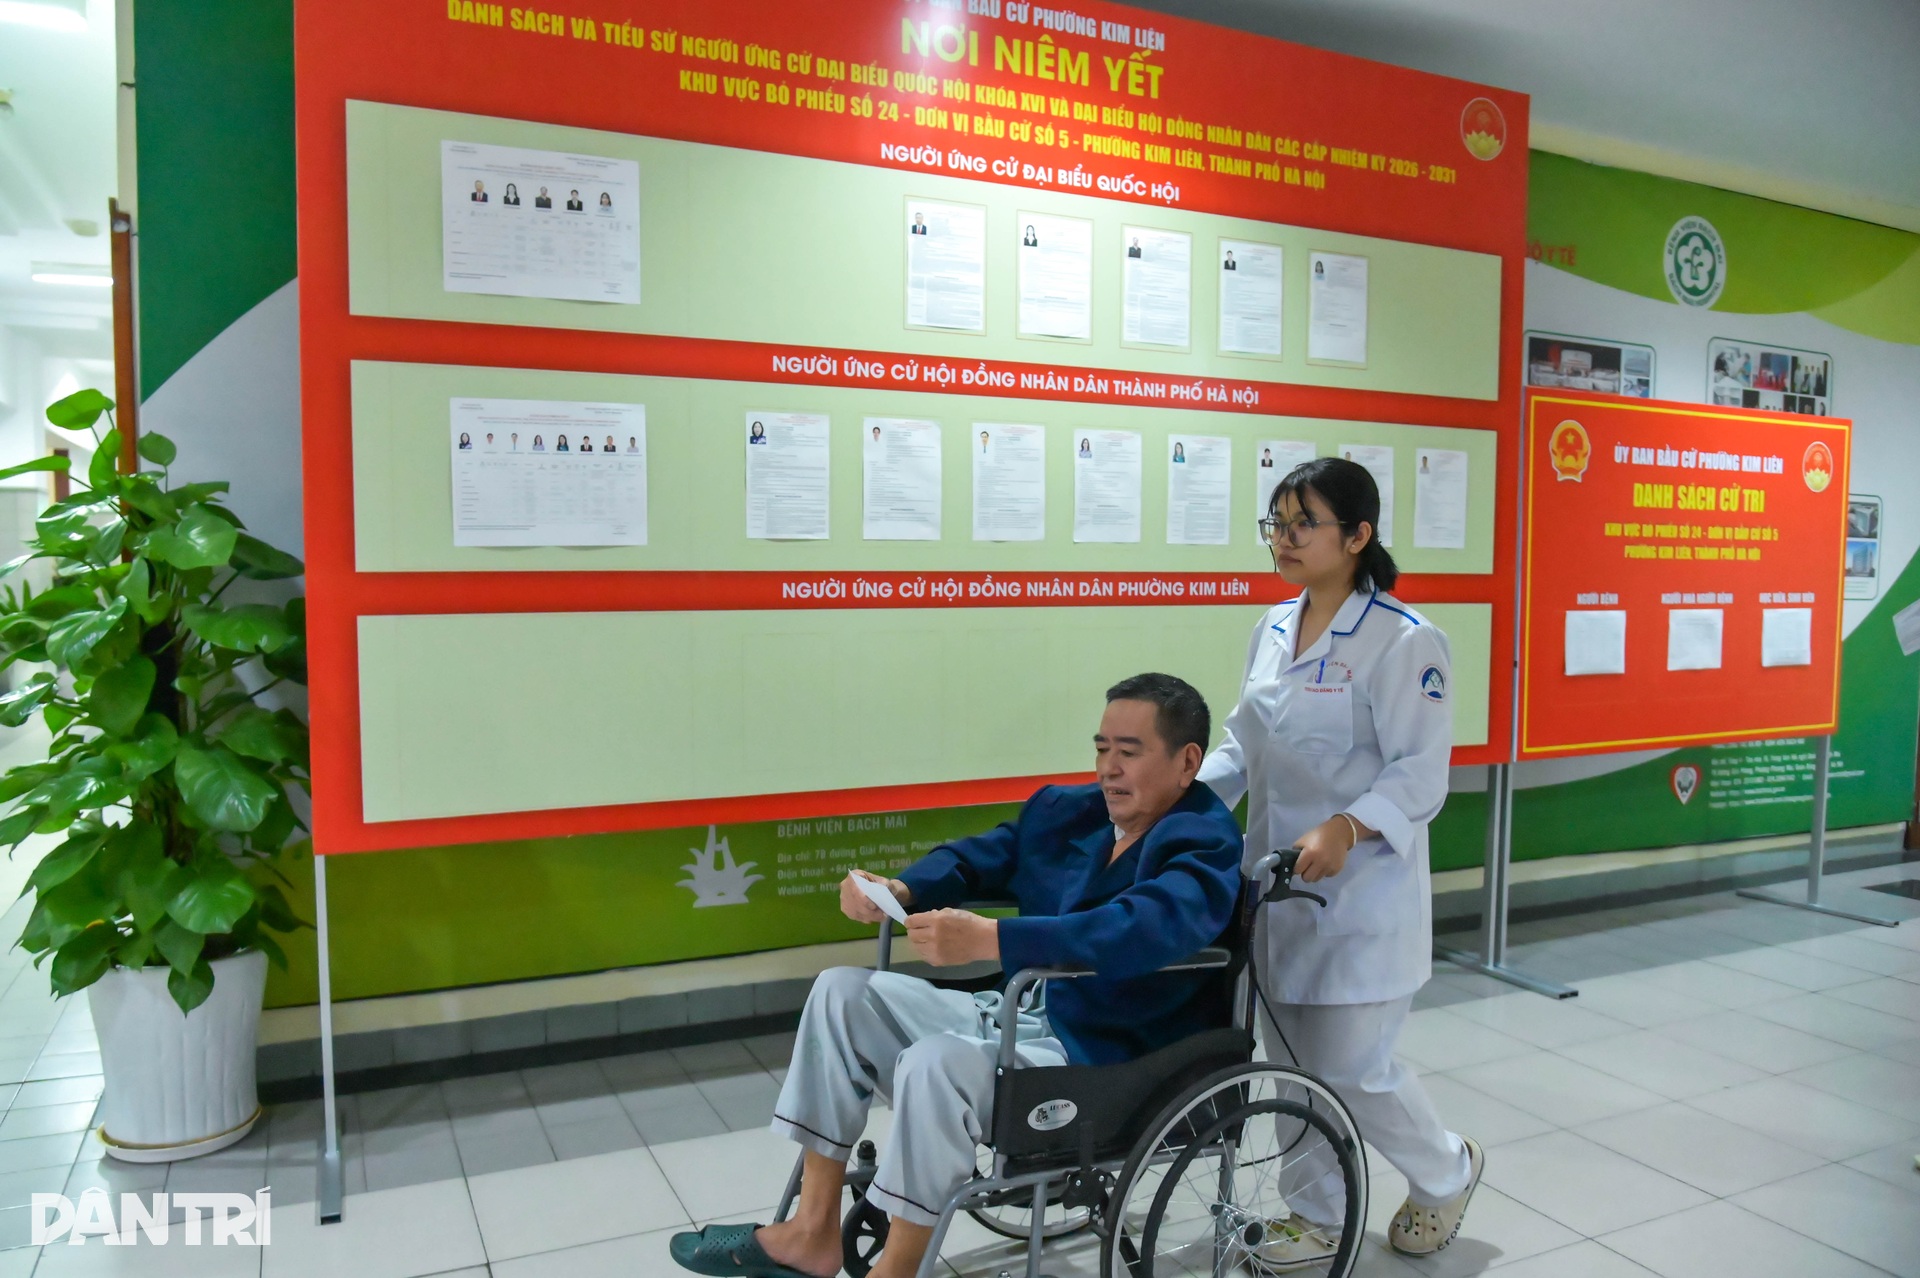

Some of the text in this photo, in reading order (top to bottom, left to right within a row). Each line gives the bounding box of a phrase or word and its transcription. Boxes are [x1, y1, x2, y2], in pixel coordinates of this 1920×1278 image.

[1033, 9, 1096, 38] PHƯỜNG
[1102, 20, 1130, 44] KIM
[1135, 27, 1165, 51] LIÊN
[901, 17, 1164, 99] NƠI NIÊM YẾT
[447, 0, 503, 27] DANH
[510, 7, 564, 36] SÁCH
[571, 16, 597, 41] VÀ
[602, 18, 644, 48] TIỂU
[650, 28, 677, 53] SỬ
[682, 35, 738, 64] NGƯỜI
[745, 42, 781, 71] ỨNG
[787, 51, 812, 75] CỬ
[816, 57, 845, 83] ĐẠI
[851, 60, 888, 88] BIỂU
[893, 66, 938, 96] QUỐC
[943, 78, 970, 103] HỘI
[975, 85, 1016, 109] KHÓA
[1021, 93, 1045, 114] XVI
[1050, 96, 1069, 118] VÀ
[1074, 101, 1098, 125] ĐẠI
[1102, 104, 1134, 129] BIỂU
[1138, 112, 1162, 136] HỘI
[1167, 114, 1203, 141] ĐỒNG
[1207, 125, 1242, 147] NHÂN
[1246, 131, 1271, 152] DÂN
[1275, 136, 1299, 157] CÁC
[1389, 158, 1418, 178] 2026
[1429, 164, 1456, 184] 2031
[680, 69, 717, 94] KHU
[723, 77, 760, 103] VỰC
[766, 80, 790, 105] BỎ
[796, 85, 845, 114] PHIẾU
[851, 92, 873, 118] SỐ
[878, 101, 899, 122] 24
[915, 106, 948, 130] ĐƠN
[952, 113, 969, 137] VỊ
[974, 111, 1005, 139] BẦU
[1009, 118, 1032, 143] CỬ
[1034, 121, 1054, 147] SỐ
[1059, 130, 1069, 149] 5
[1083, 133, 1141, 160] PHƯỜNG
[1145, 143, 1171, 165] KIM
[1175, 147, 1205, 172] LIÊN,
[1209, 153, 1251, 178] THÀNH
[1255, 159, 1280, 183] PHỐ
[1284, 166, 1300, 186] HÀ
[1304, 169, 1326, 191] NỘI
[881, 142, 1180, 204] NGƯỜI ỨNG CỬ ĐẠI BIỂU QUỐC HỘI
[772, 354, 1259, 408] NGƯỜI ỨNG CỬ HỘI ĐỒNG NHÂN DÂN THÀNH PHỐ HÀ NỘI
[1614, 441, 1784, 474] ỦY BAN BẦU CỬ PHƯỜNG KIM LIÊN
[1633, 482, 1765, 513] DANH SÁCH CỬ TRI
[782, 574, 1249, 602] NGƯỜI ỨNG CỬ HỘI ĐỒNG NHÂN DÂN PHƯỜNG KIM LIÊN
[777, 815, 907, 838] BỆNH VIỆN BẠCH MAI
